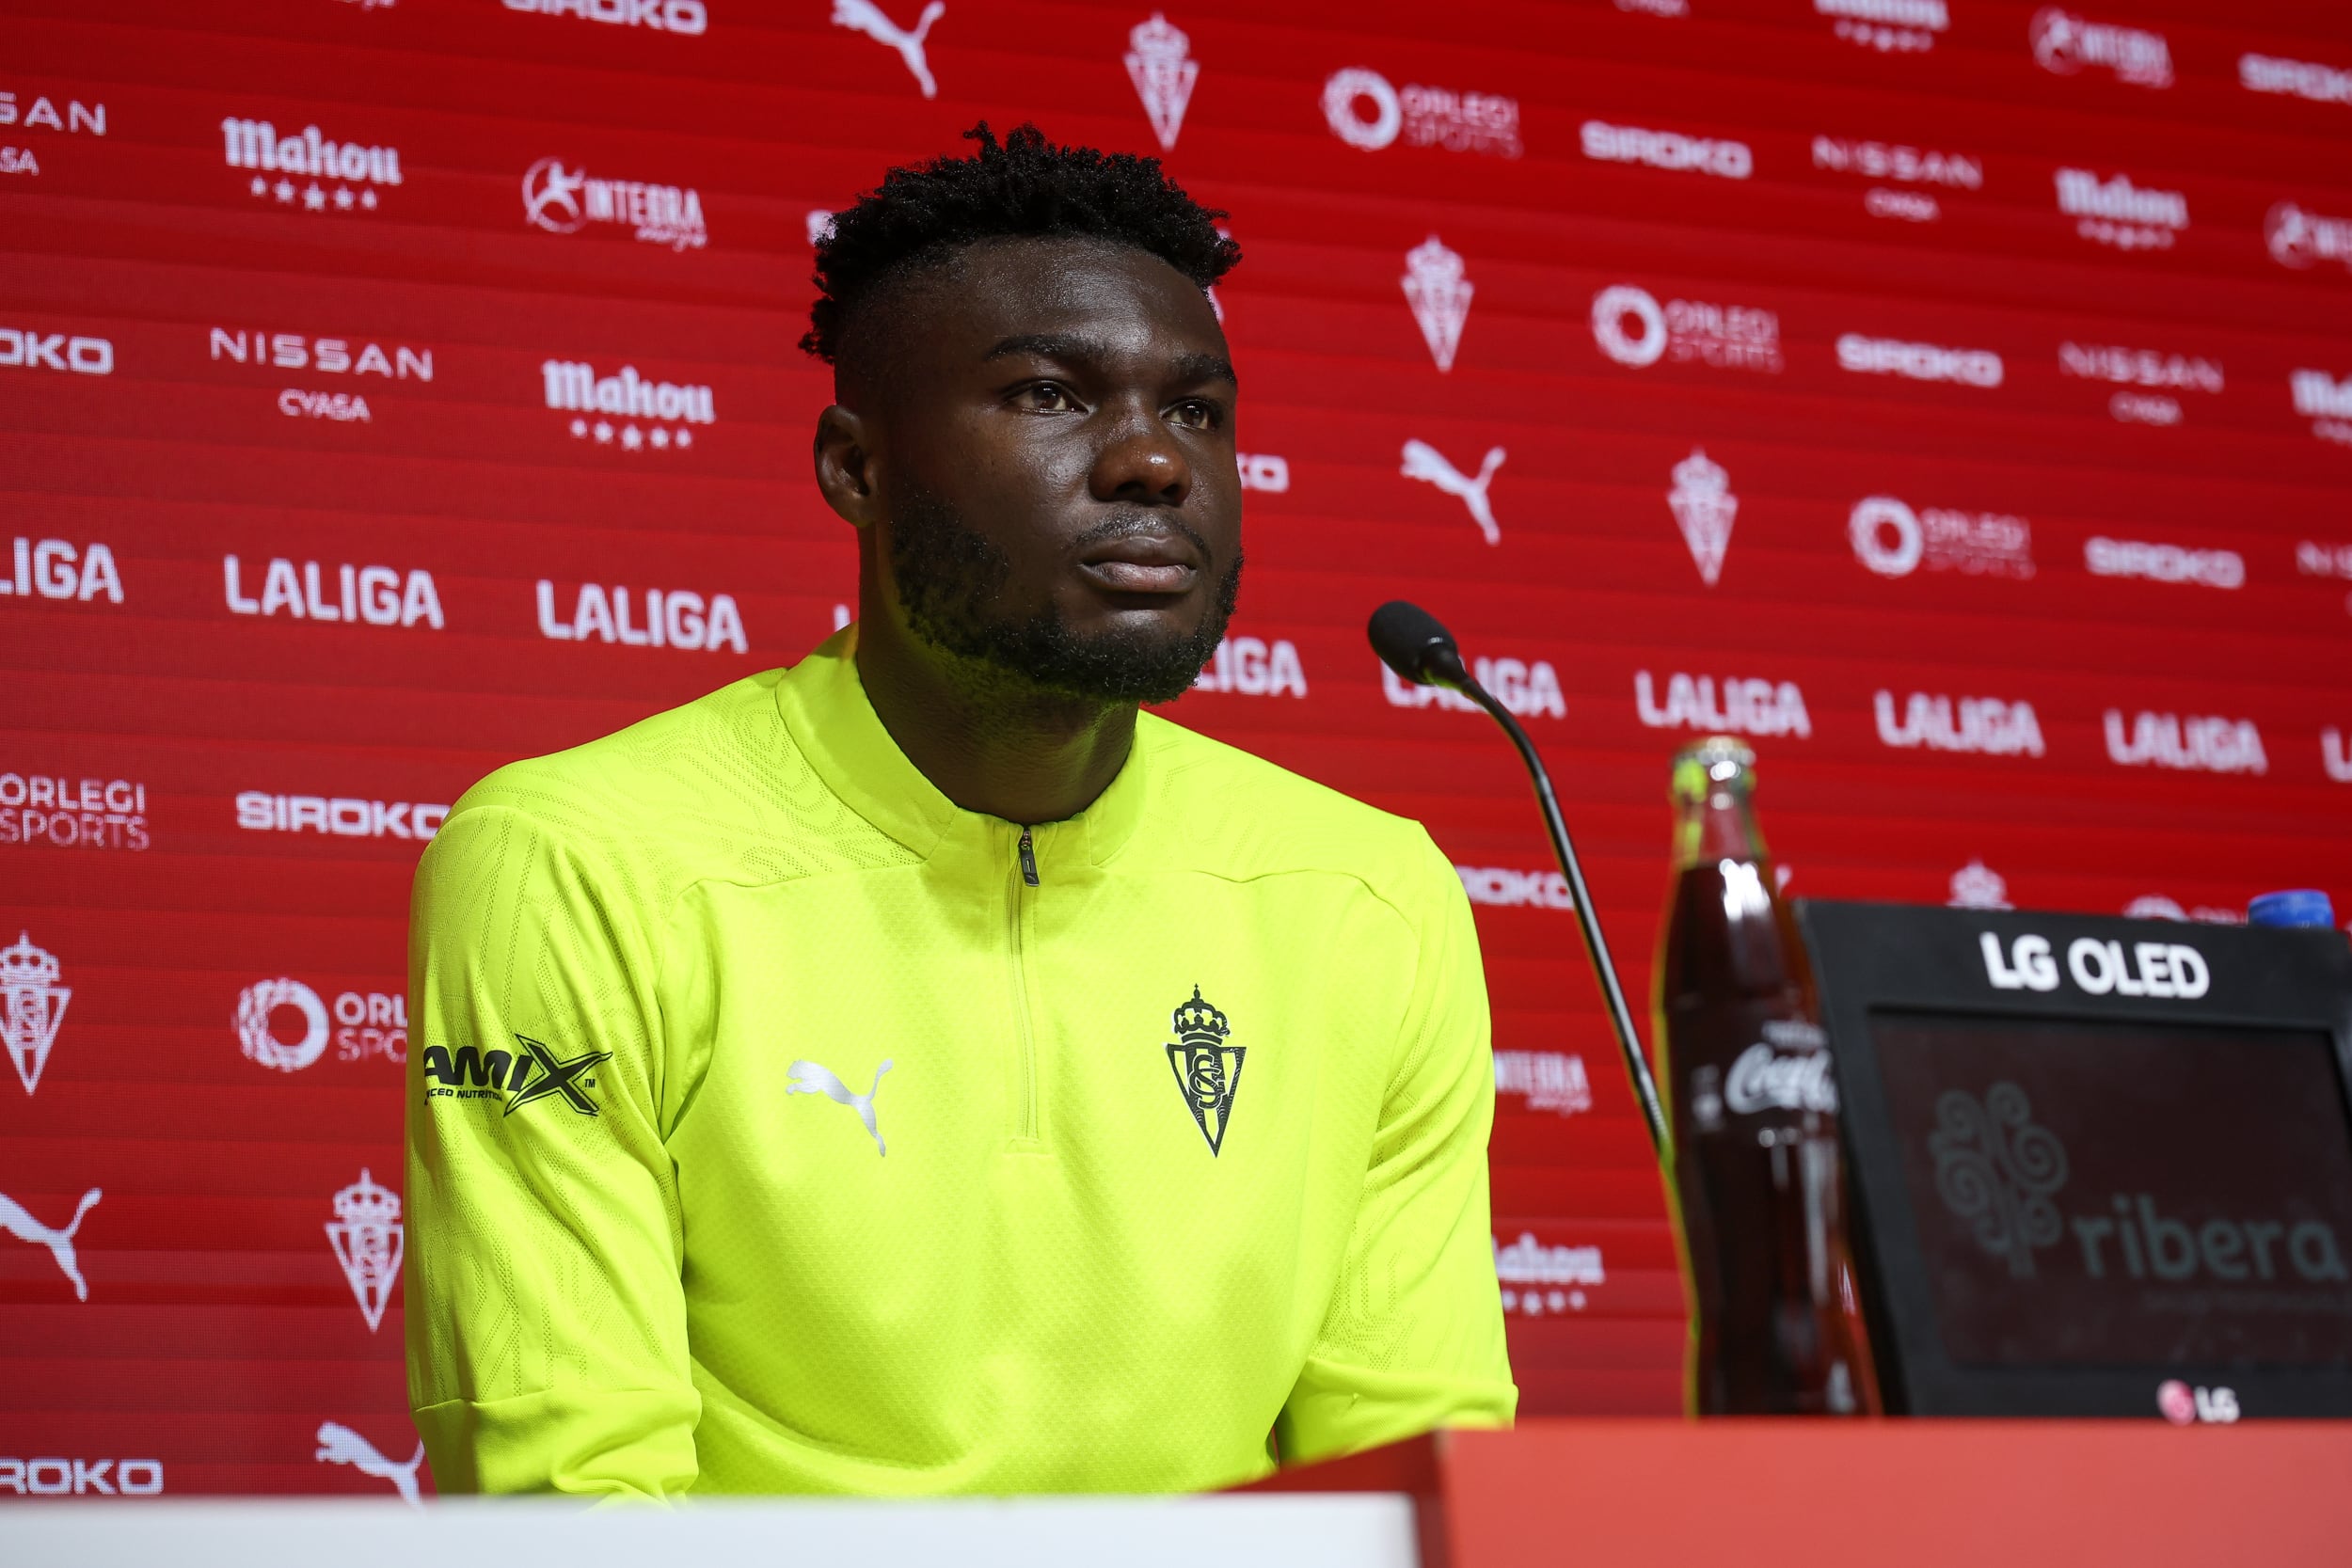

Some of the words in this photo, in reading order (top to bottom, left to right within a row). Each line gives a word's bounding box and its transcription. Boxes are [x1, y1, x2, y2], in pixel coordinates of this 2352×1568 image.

[221, 116, 403, 184] Mahou
[1581, 119, 1753, 180] SIROKO
[1812, 135, 1983, 189] NISSAN
[210, 326, 434, 381] NISSAN
[1836, 333, 2004, 388] SIROKO
[542, 359, 716, 423] Mahou
[224, 554, 444, 629] LALIGA
[536, 579, 748, 654] LALIGA
[1635, 671, 1810, 737] LALIGA
[1875, 689, 2044, 757] LALIGA
[2105, 710, 2267, 775] LALIGA
[0, 773, 144, 814] ORLEGI
[1980, 931, 2058, 991] LG
[2069, 938, 2209, 999] OLED
[1493, 1233, 1605, 1284] ahou
[2074, 1194, 2348, 1280] ribera
[2195, 1386, 2240, 1423] LG
